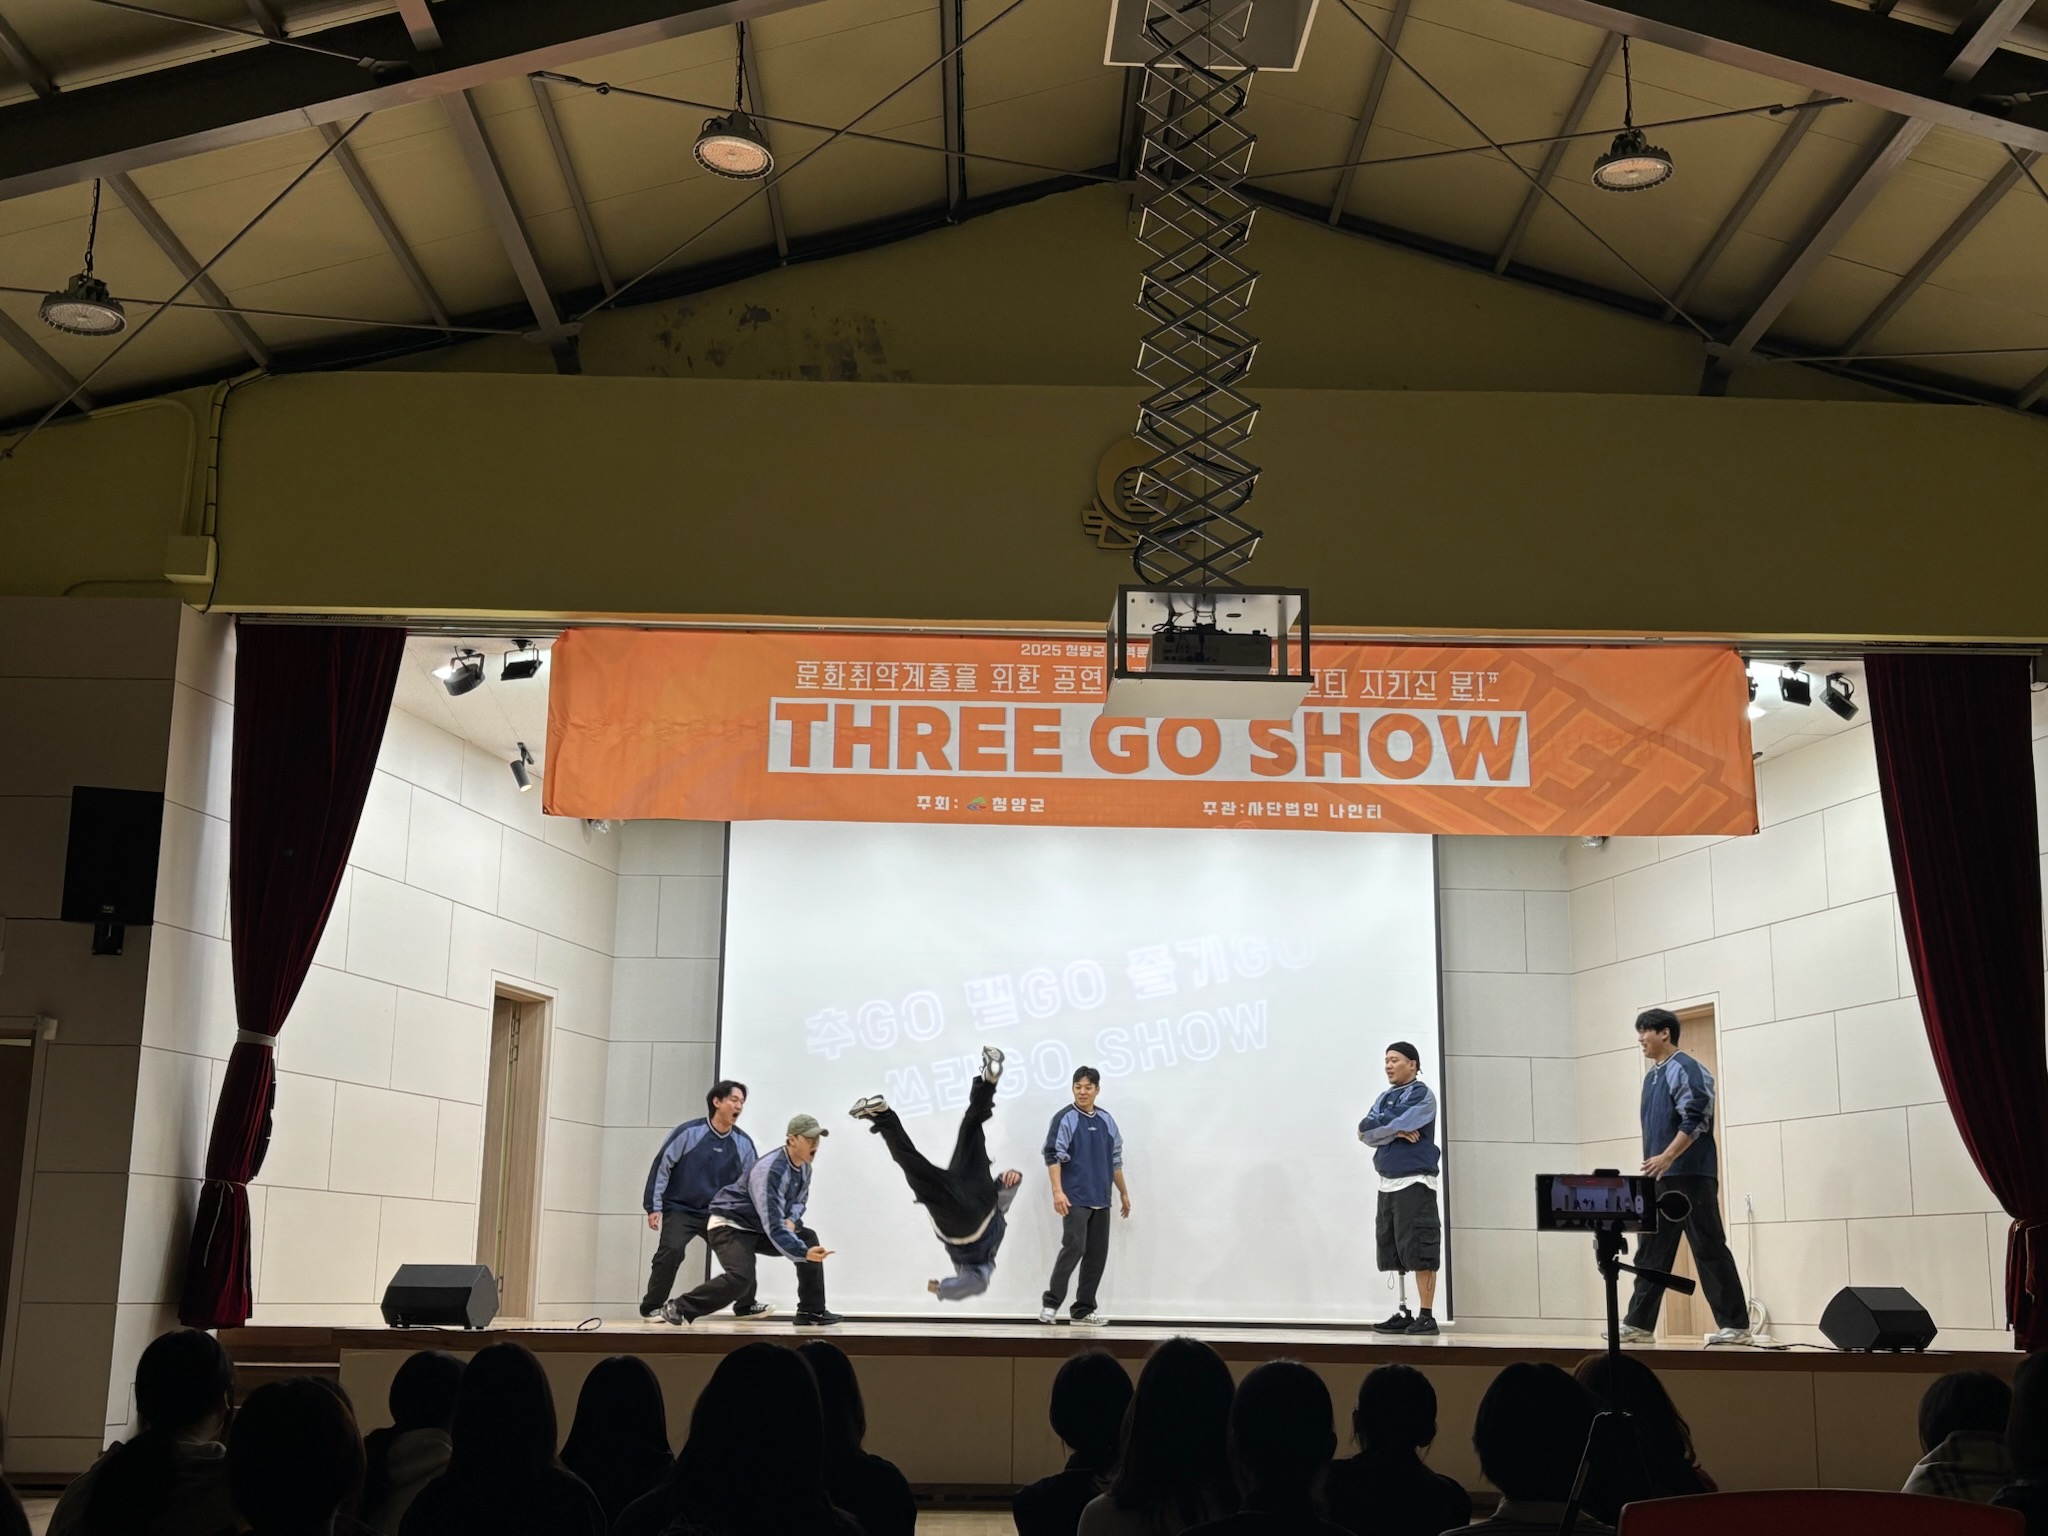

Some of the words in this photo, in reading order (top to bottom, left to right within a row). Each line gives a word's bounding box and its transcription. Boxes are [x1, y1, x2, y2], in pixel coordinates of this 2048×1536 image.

[1021, 643, 1061, 657] 2025
[1065, 644, 1105, 658] 청양군
[795, 660, 979, 692] 문화취약계층을
[990, 663, 1041, 694] 위한
[1052, 665, 1104, 695] 공연
[1359, 669, 1438, 701] 시키신
[775, 703, 1063, 773] THREE
[1090, 716, 1222, 776] GO
[1249, 711, 1522, 781] SHOW
[992, 797, 1045, 813] 청양군
[1329, 803, 1382, 820] 나인티
[804, 990, 944, 1060] 추GO
[1095, 1000, 1268, 1078] SHOW
